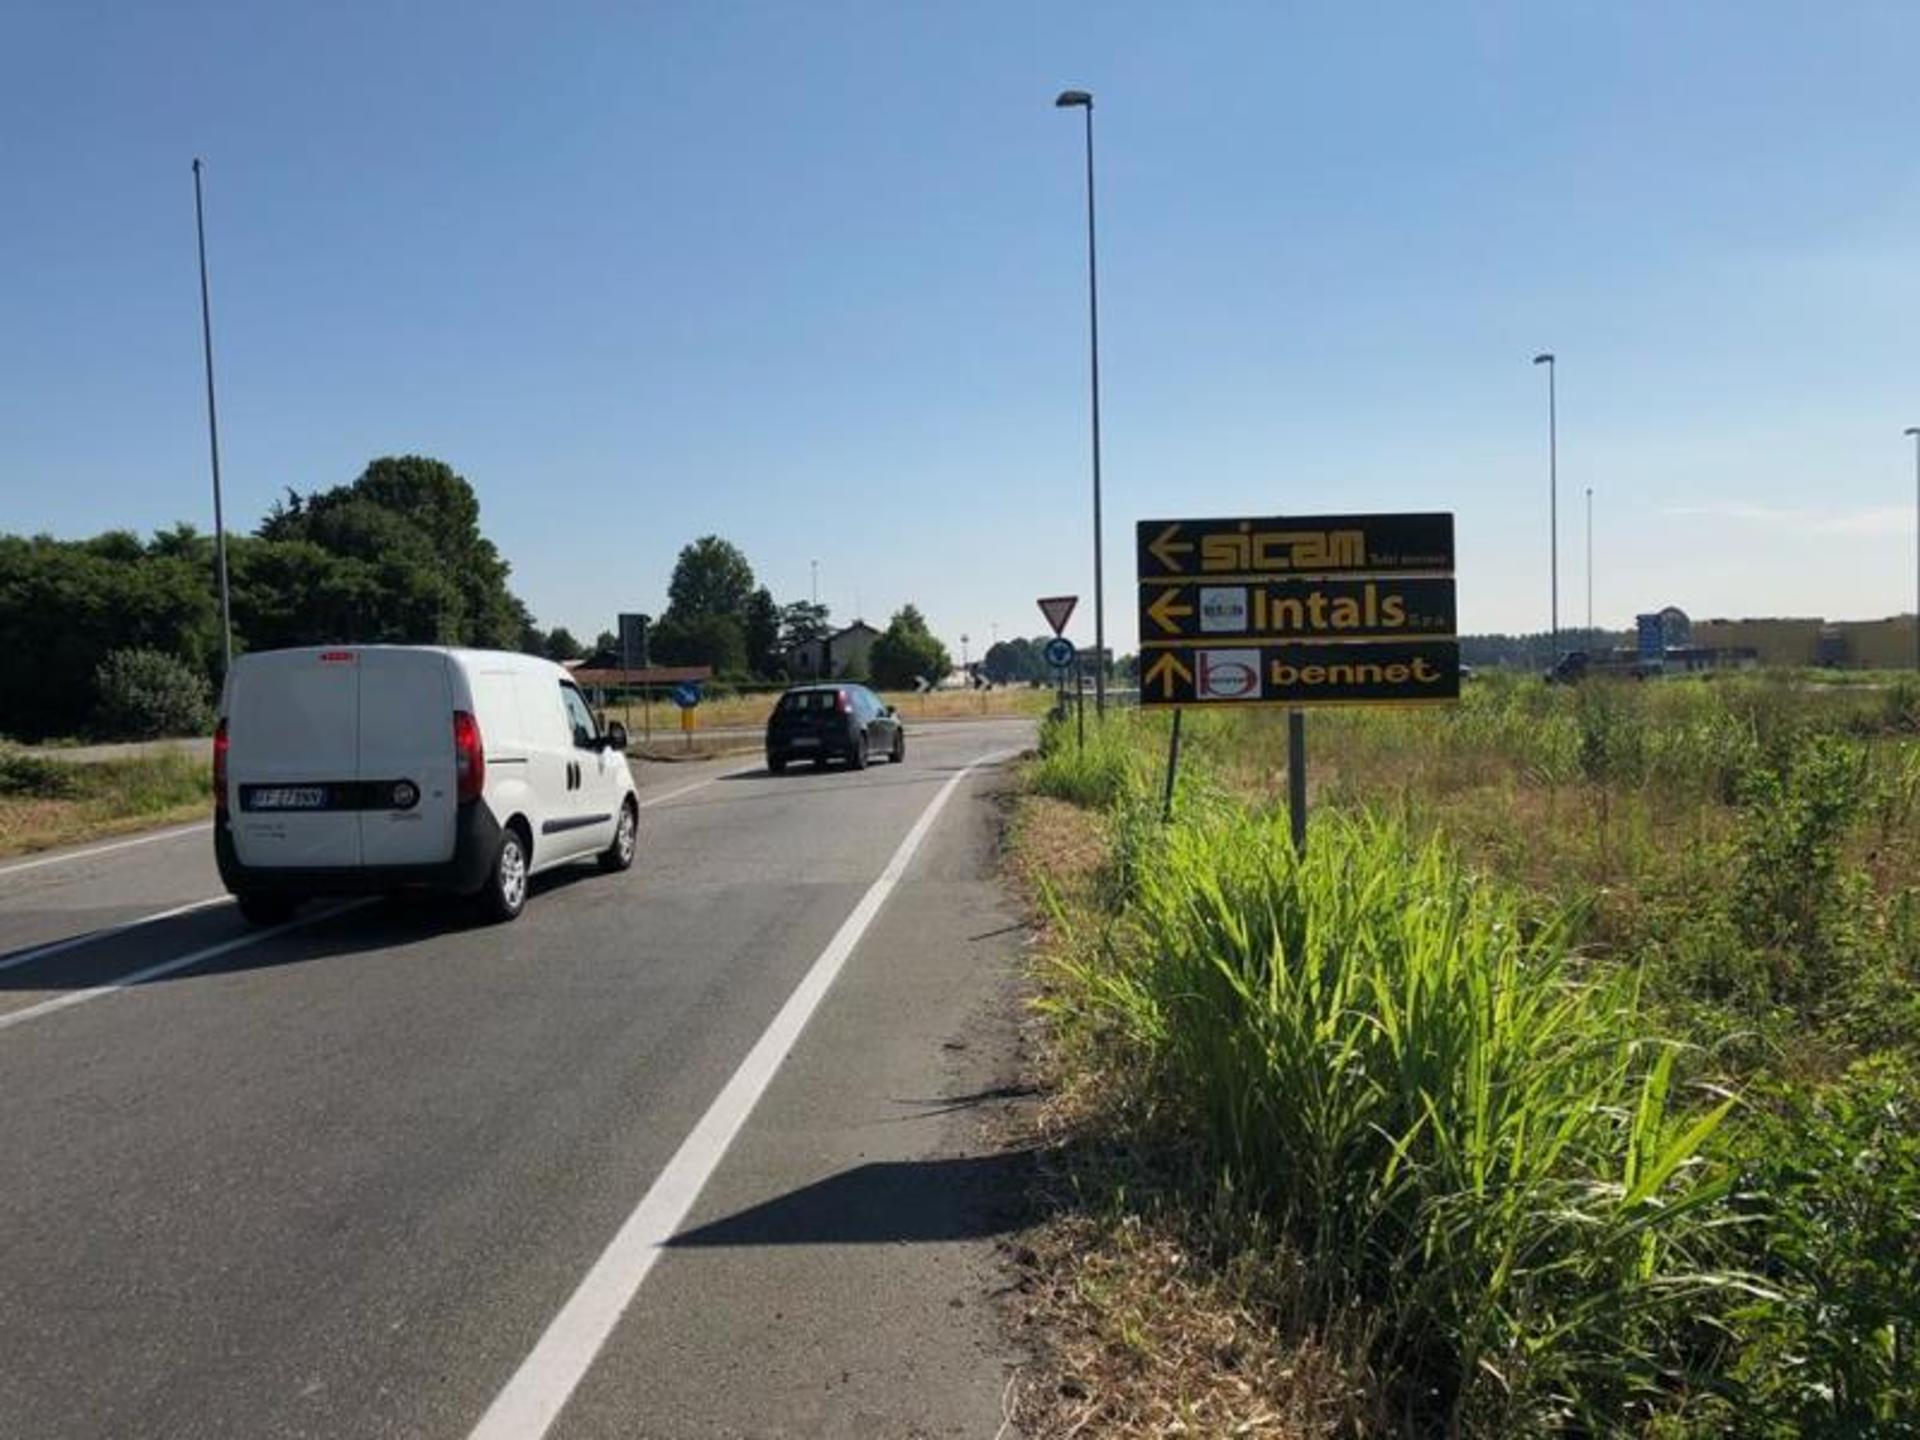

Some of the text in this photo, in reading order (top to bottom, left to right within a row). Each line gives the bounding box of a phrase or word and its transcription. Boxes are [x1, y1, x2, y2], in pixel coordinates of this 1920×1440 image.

[1201, 522, 1365, 570] sicam
[1254, 583, 1405, 630] Intals
[1270, 655, 1442, 686] bennet
